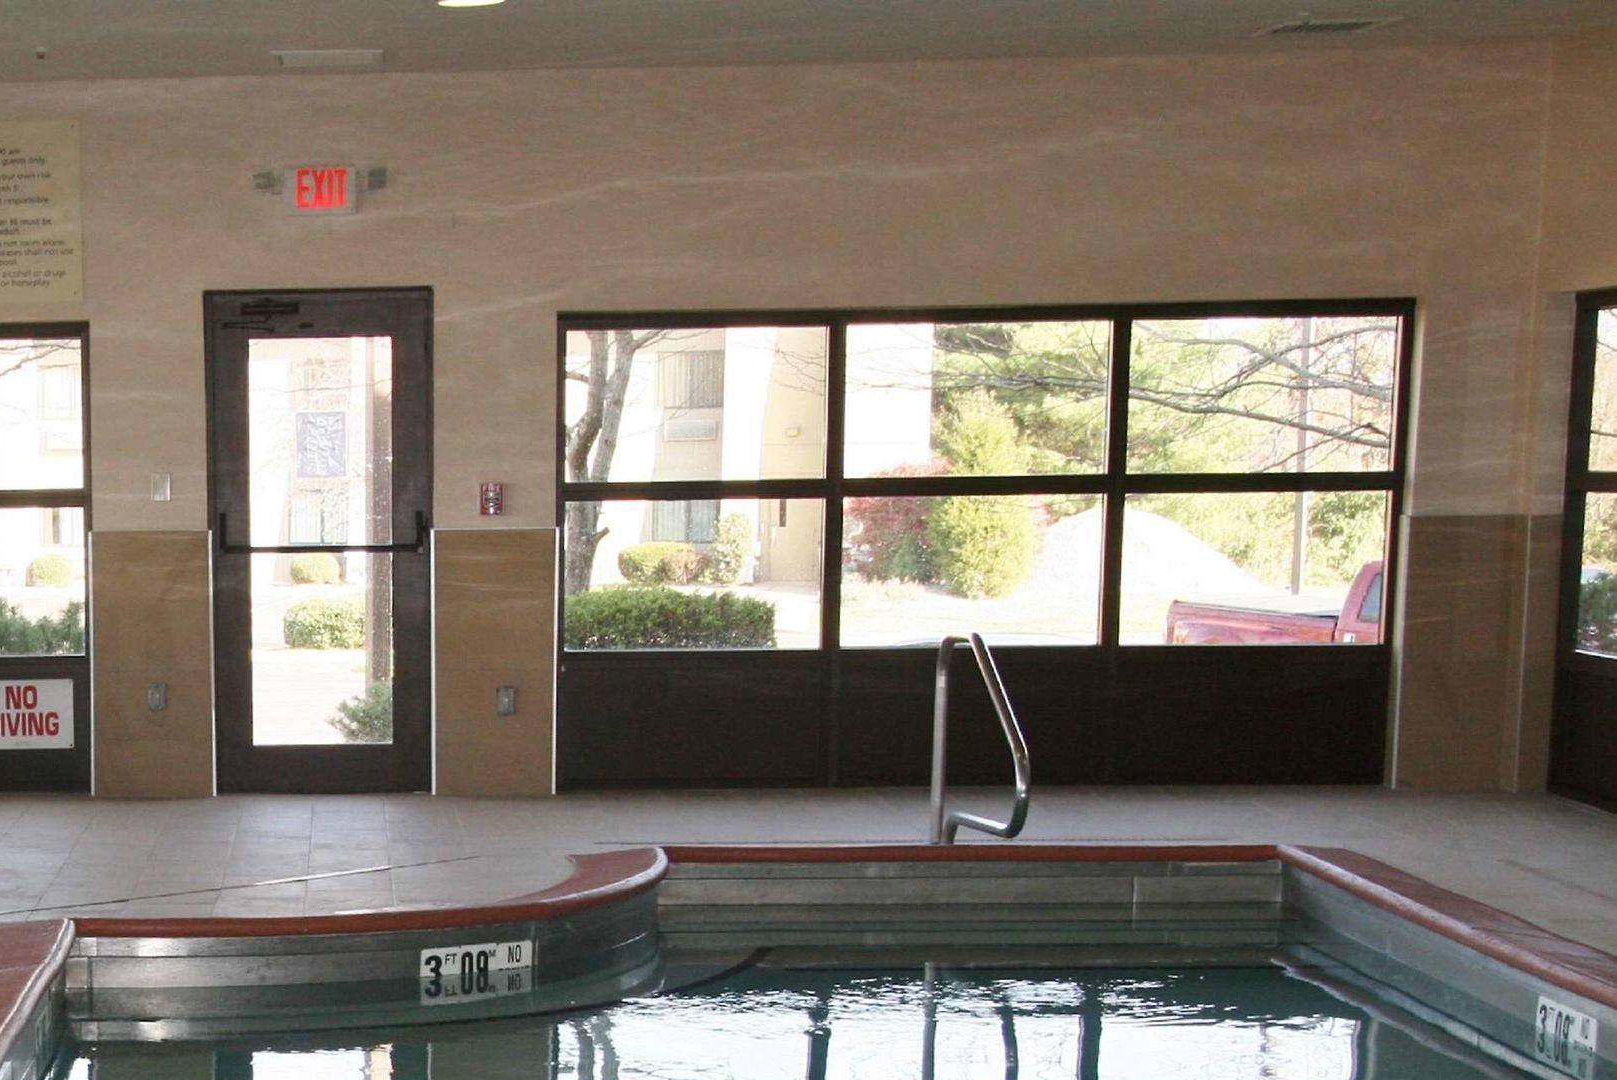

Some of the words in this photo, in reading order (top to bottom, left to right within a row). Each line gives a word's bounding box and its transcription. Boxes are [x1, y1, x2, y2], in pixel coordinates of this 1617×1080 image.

[2, 157, 26, 166] guests
[17, 173, 35, 181] own
[296, 166, 348, 209] EXIT
[3, 196, 49, 206] responsible
[20, 217, 39, 226] must
[42, 217, 52, 225] be
[3, 240, 17, 248] not
[19, 239, 40, 247] swim
[24, 246, 43, 256] shall
[44, 247, 59, 256] not
[60, 247, 74, 255] use
[1, 268, 32, 278] alcohol
[44, 268, 66, 279] drugs
[0, 279, 9, 287] or
[5, 685, 38, 710] NO
[444, 953, 457, 965] FT
[507, 944, 522, 963] NO
